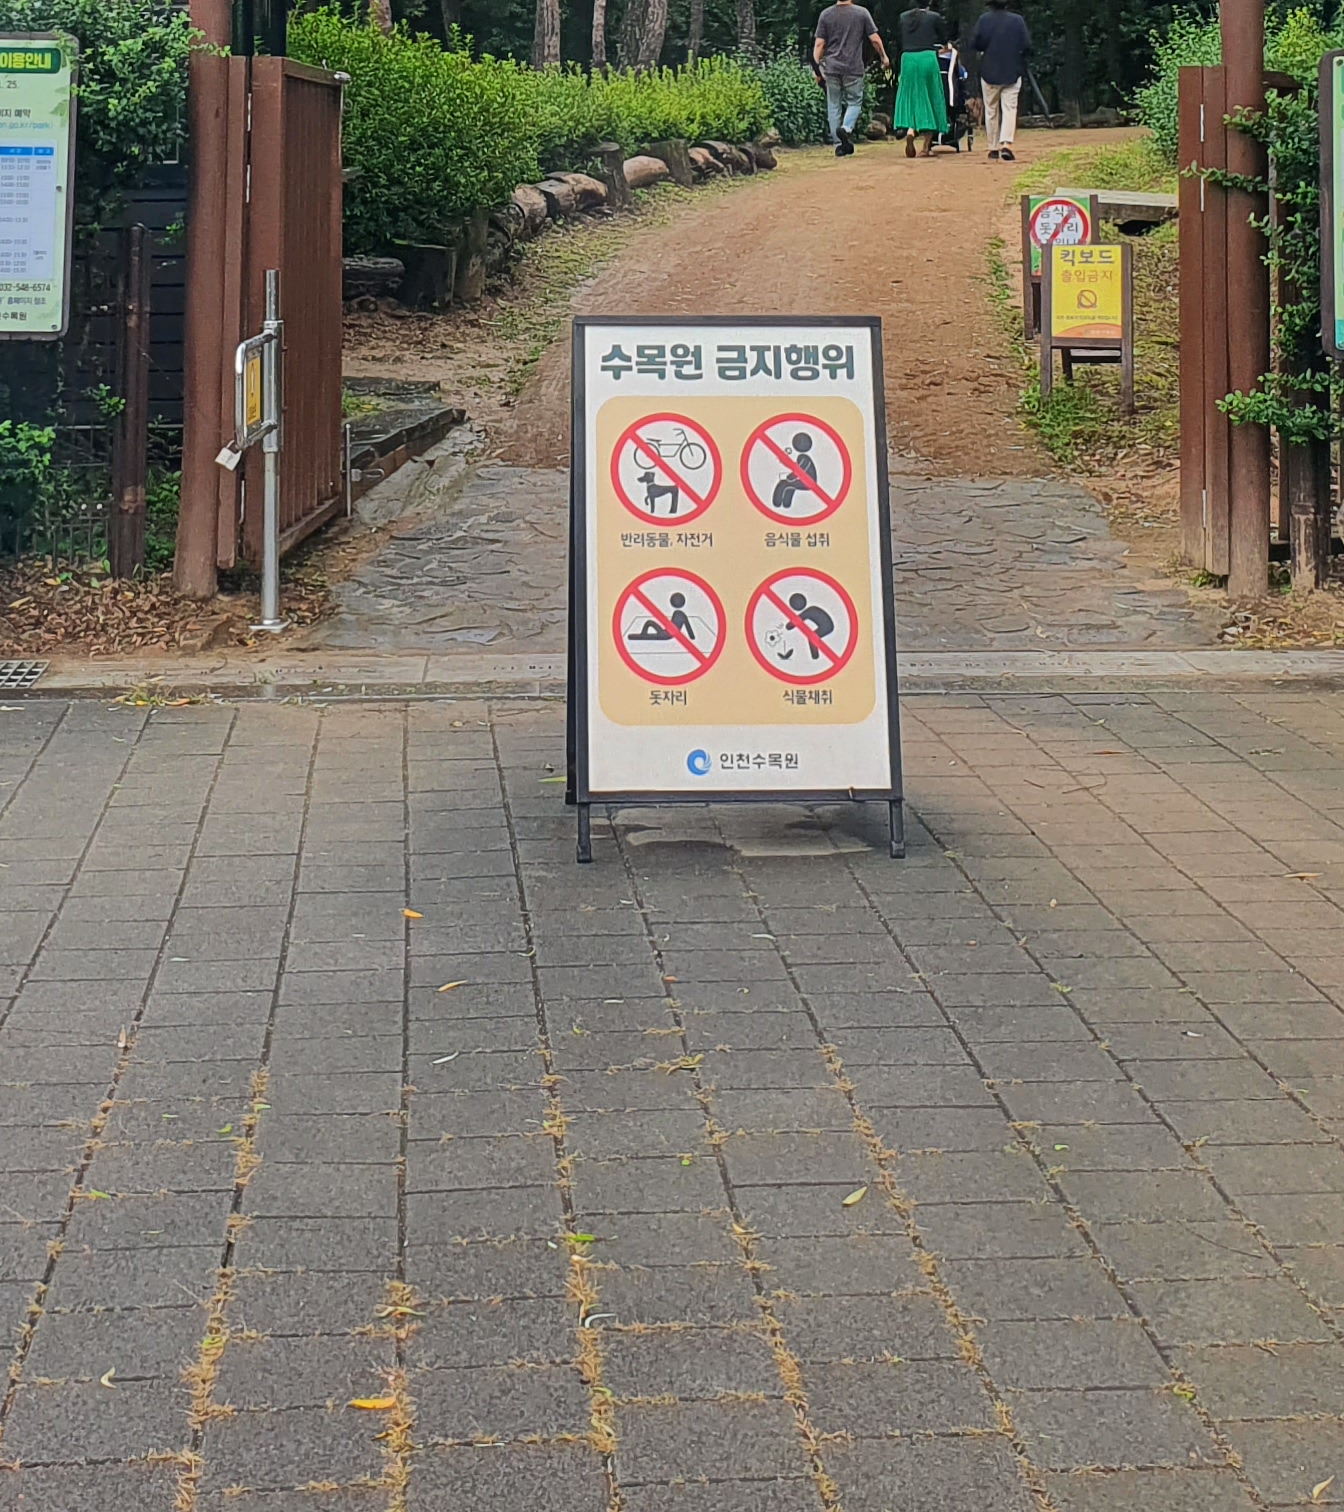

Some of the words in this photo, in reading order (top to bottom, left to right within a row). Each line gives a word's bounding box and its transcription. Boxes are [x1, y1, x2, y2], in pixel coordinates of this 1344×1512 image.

[0, 53, 52, 69] 이용안내
[14, 109, 31, 118] 예약
[1060, 249, 1114, 266] 킥보드
[1061, 270, 1113, 283] 출입금지
[600, 344, 704, 381] 수목원
[715, 344, 855, 381] 금지행위
[620, 532, 673, 548] 반려동물,
[676, 532, 713, 548] 자전거
[764, 532, 802, 547] 음식물
[805, 532, 830, 547] 섭취
[649, 690, 687, 705] 돗자리
[782, 689, 833, 705] 식물채취
[720, 753, 799, 770] 인천수목원
